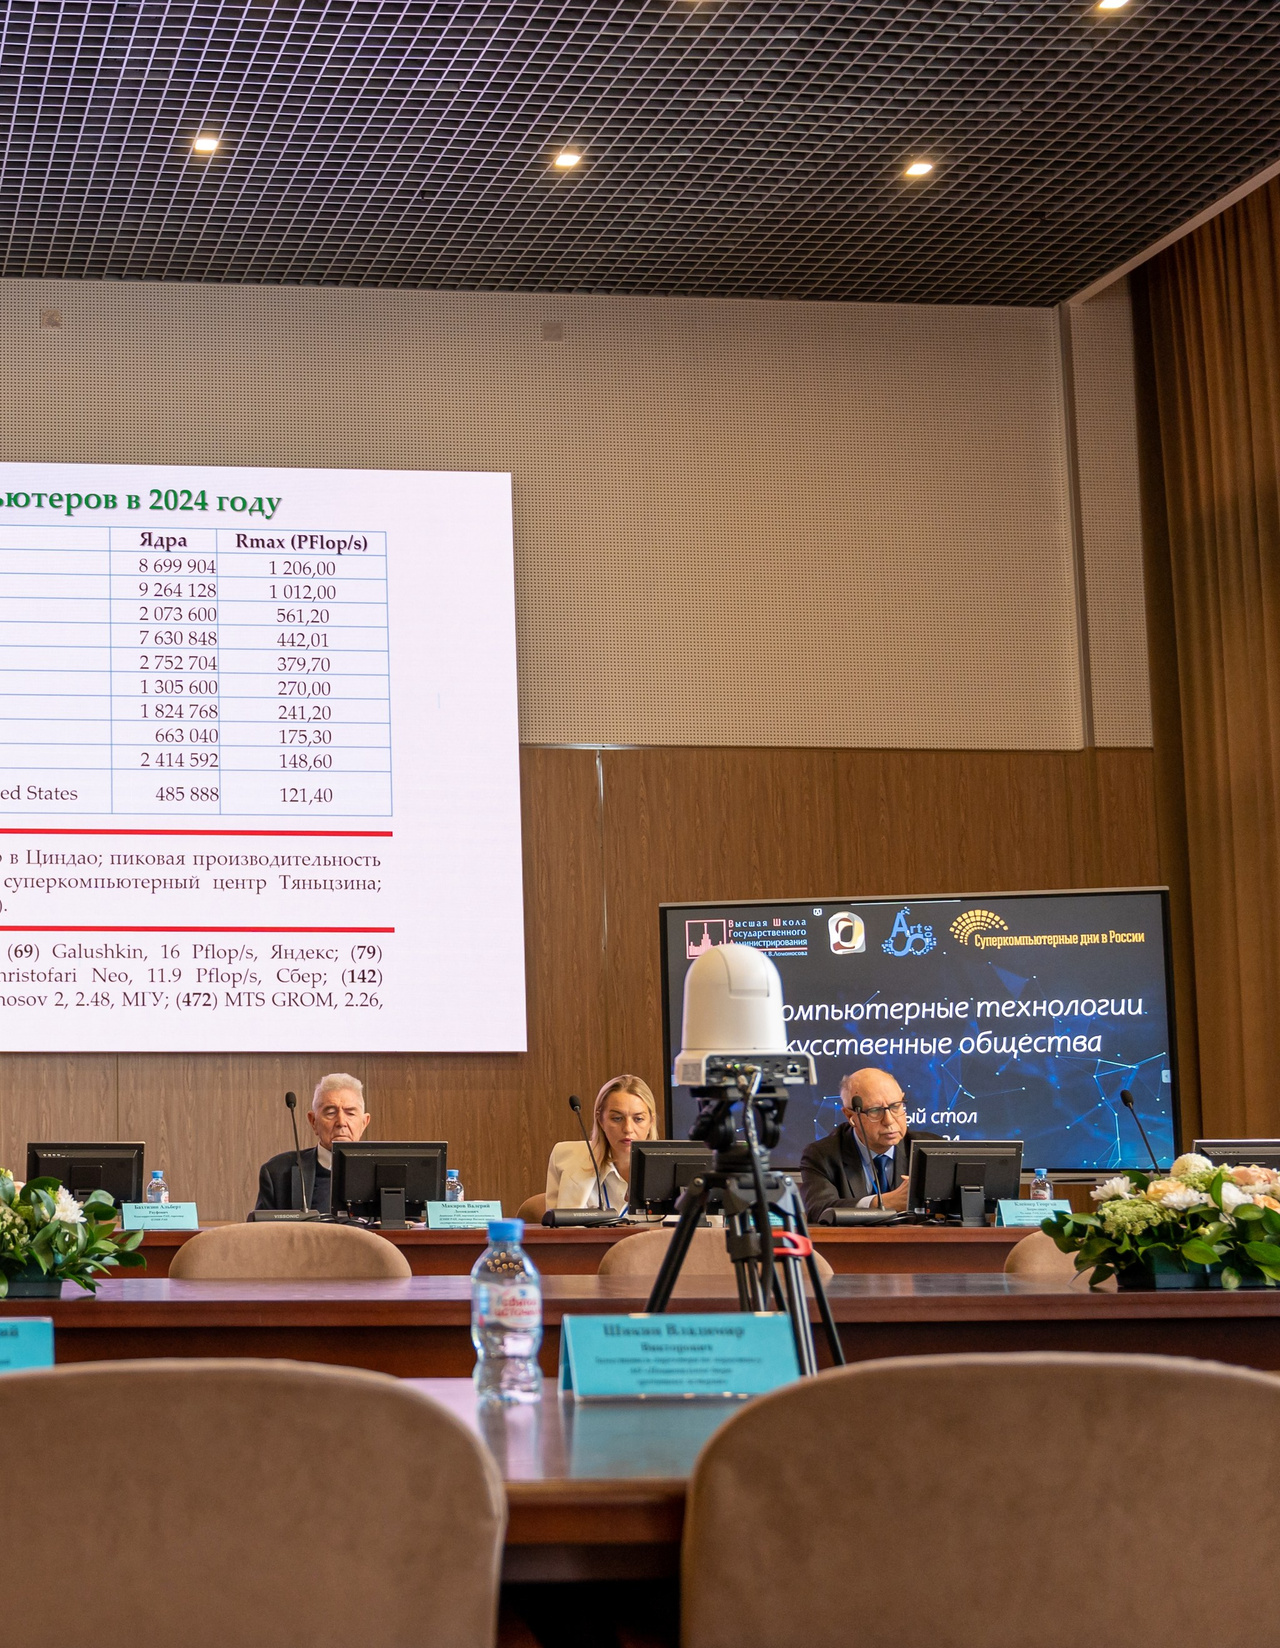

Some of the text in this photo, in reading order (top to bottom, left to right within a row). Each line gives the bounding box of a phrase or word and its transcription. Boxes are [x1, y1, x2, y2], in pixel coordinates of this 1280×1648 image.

[125, 494, 141, 510] в
[148, 488, 209, 511] 2024
[216, 495, 283, 521] году
[139, 531, 189, 552] Ядра
[235, 533, 369, 555] Rmax (PFlop/s)
[269, 560, 337, 580] 1 206,00
[269, 584, 337, 604] 1 012,00
[276, 608, 330, 627] 561,20
[276, 632, 329, 651] 442,01
[277, 656, 331, 675] 379,70
[277, 680, 331, 699] 270,00
[278, 705, 332, 724] 241,20
[280, 729, 332, 748] 175,30
[279, 753, 333, 772] 148,60
[26, 785, 78, 801] States
[280, 787, 333, 806] 121,40
[10, 853, 19, 865] в
[26, 849, 103, 868] Циндао;
[110, 854, 186, 866] пиковая
[193, 854, 381, 871] производительность
[3, 877, 200, 895] суперкомпьютерный
[213, 878, 267, 895] центр
[278, 874, 381, 893] Тяньцзина;
[728, 918, 807, 928] Высшая Школа
[728, 929, 807, 939] Государственного
[974, 930, 1145, 949] Суперкомпьютерные дни в России
[7, 943, 40, 963] (69)
[52, 943, 148, 962] Galushkin,
[161, 944, 180, 959] 16
[193, 943, 258, 965] Pflop/s,
[270, 944, 339, 962] Яндекс;
[350, 945, 383, 964] (79)
[92, 967, 133, 986] Neo,
[148, 967, 182, 983] 11.9
[196, 967, 262, 989] Pflop/s,
[276, 968, 327, 989] Сбер;
[341, 968, 383, 988] (142)
[54, 991, 69, 1009] 2,
[75, 991, 115, 1009] 2.48,
[122, 991, 169, 1010] МГУ;
[175, 992, 218, 1011] (472)
[225, 991, 266, 1007] MTS
[271, 991, 338, 1010] GROM,
[344, 991, 383, 1010] 2.26,
[781, 998, 1143, 1025] омпьютерные технологии
[959, 1030, 1102, 1059] общества
[930, 1111, 978, 1124] стол
